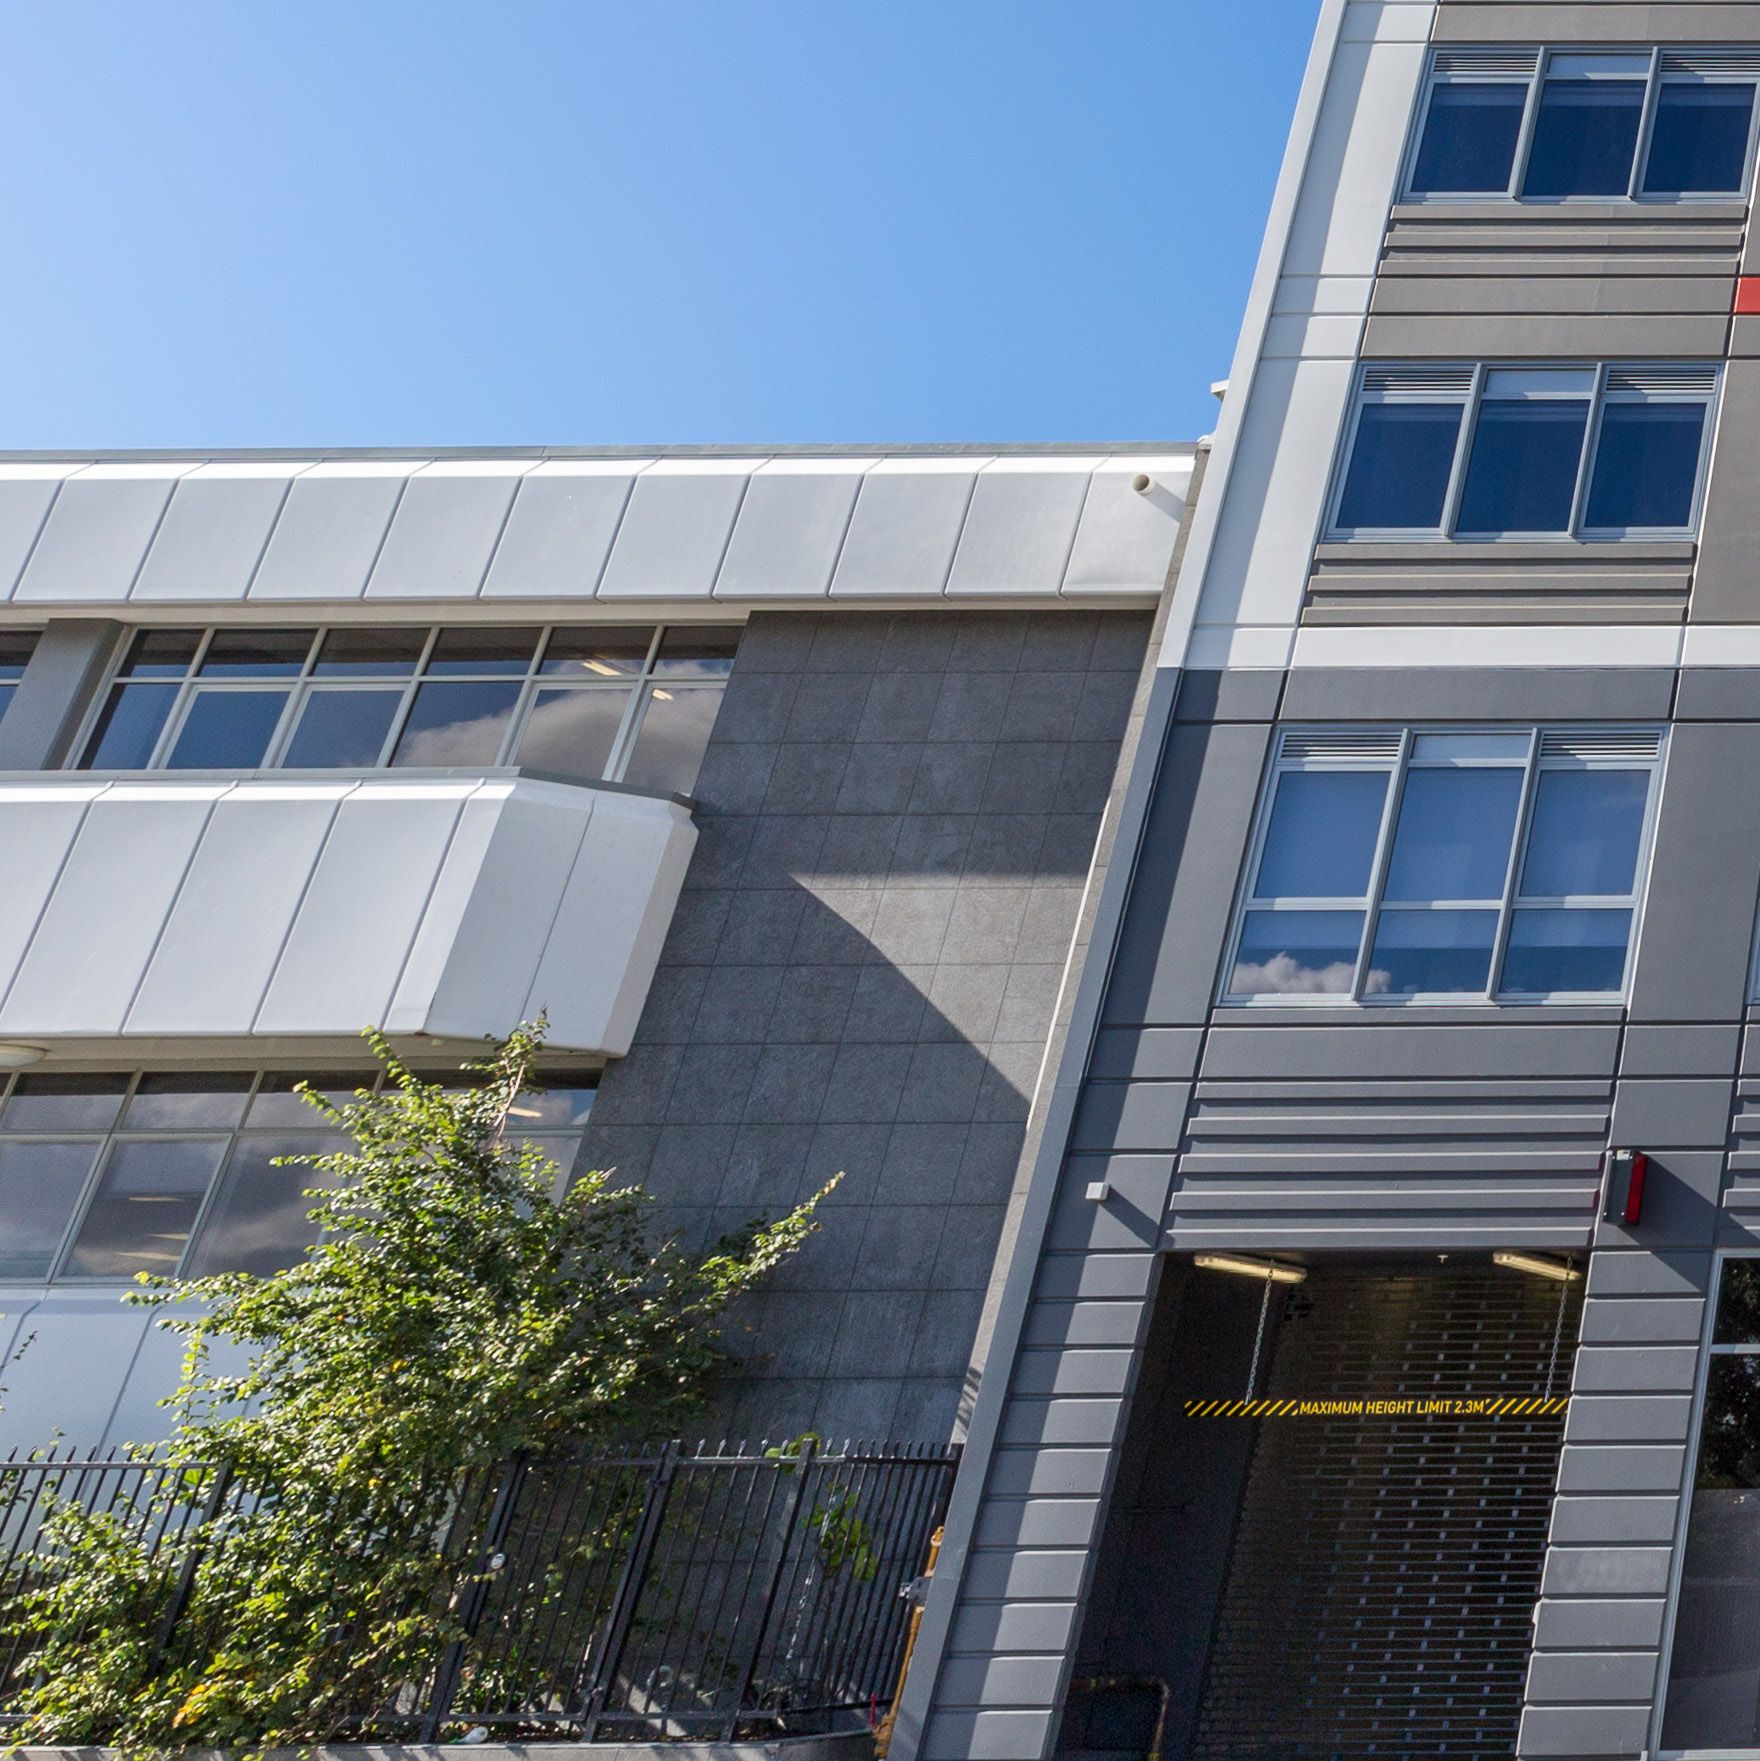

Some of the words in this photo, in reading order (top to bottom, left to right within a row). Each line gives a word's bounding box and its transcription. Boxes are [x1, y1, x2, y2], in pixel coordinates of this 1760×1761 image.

[1300, 1401, 1363, 1415] MAXIMUM
[1365, 1401, 1414, 1414] HEIGHT
[1416, 1400, 1453, 1414] LIMIT
[1454, 1400, 1485, 1414] 2.3M
